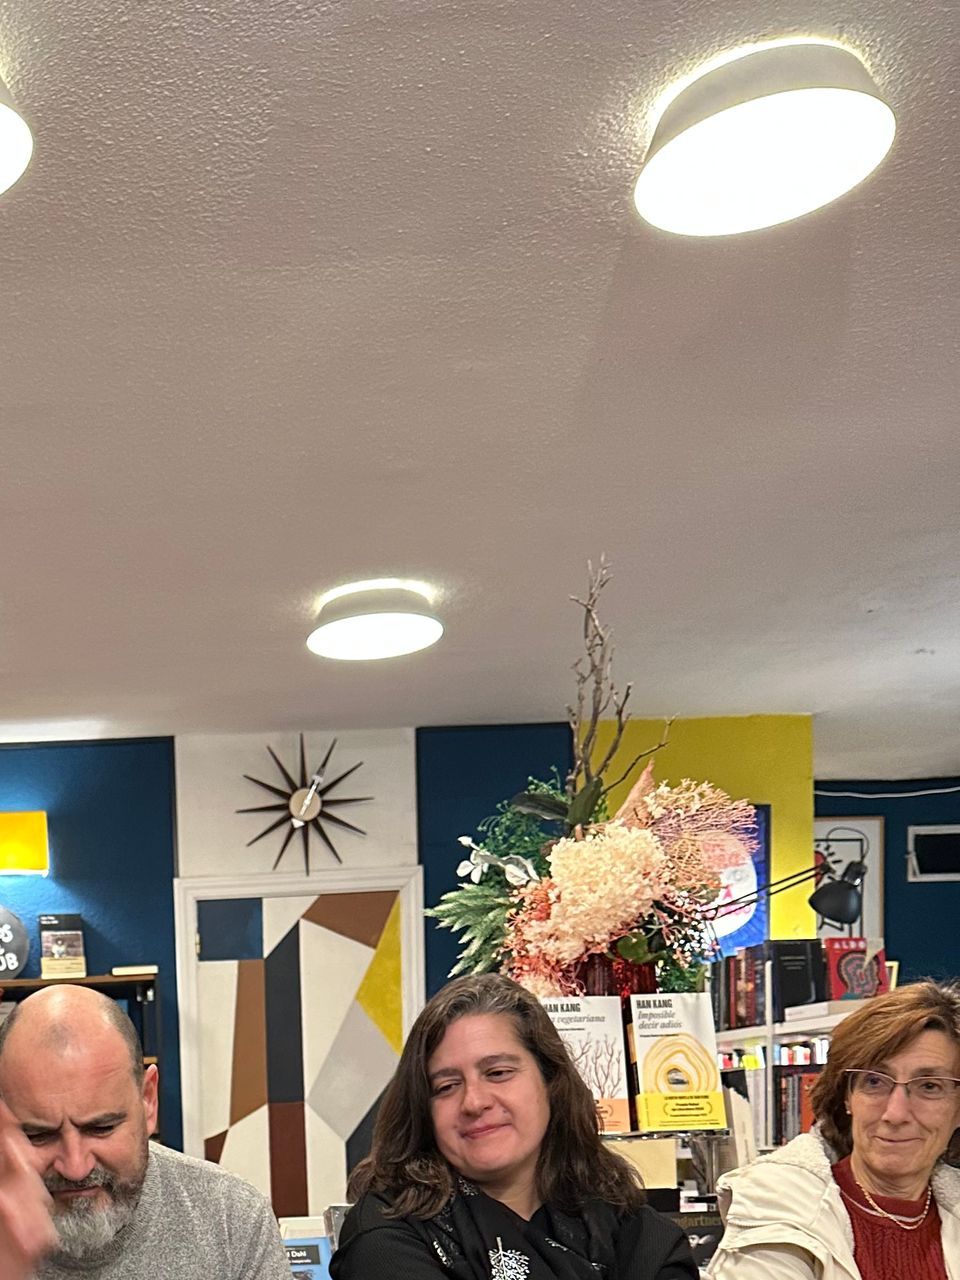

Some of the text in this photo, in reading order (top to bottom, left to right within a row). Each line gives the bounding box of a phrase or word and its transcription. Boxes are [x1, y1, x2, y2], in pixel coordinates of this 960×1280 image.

[560, 1002, 581, 1013] KANG
[637, 998, 673, 1009] HAN KANG
[557, 1014, 605, 1026] vegetariana
[638, 1010, 676, 1021] Imposible
[638, 1021, 658, 1030] decir
[290, 1250, 307, 1258] Dahl
